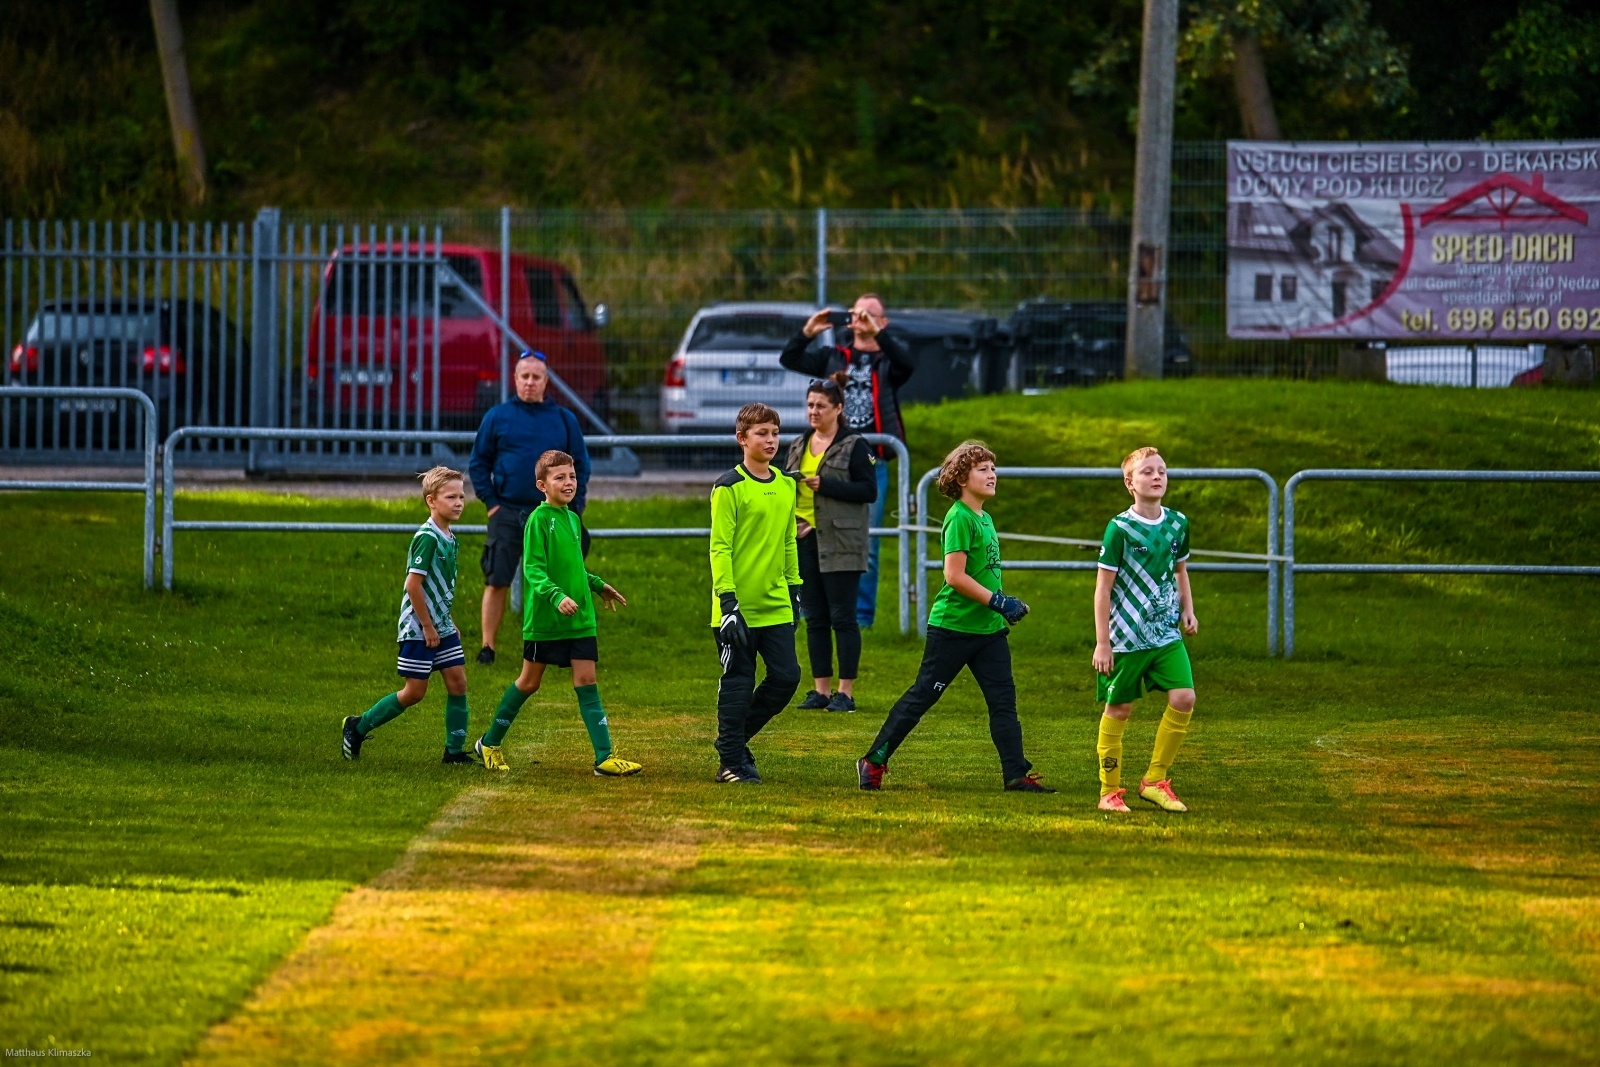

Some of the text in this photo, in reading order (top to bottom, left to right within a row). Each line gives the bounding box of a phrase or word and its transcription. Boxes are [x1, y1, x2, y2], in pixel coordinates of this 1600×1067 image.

[1327, 152, 1463, 173] CIESIELSKO
[1483, 150, 1600, 172] DEKARSK
[1236, 176, 1447, 198] DOMY POD KLUCZ
[1401, 306, 1600, 331] tel. 698 650 692
